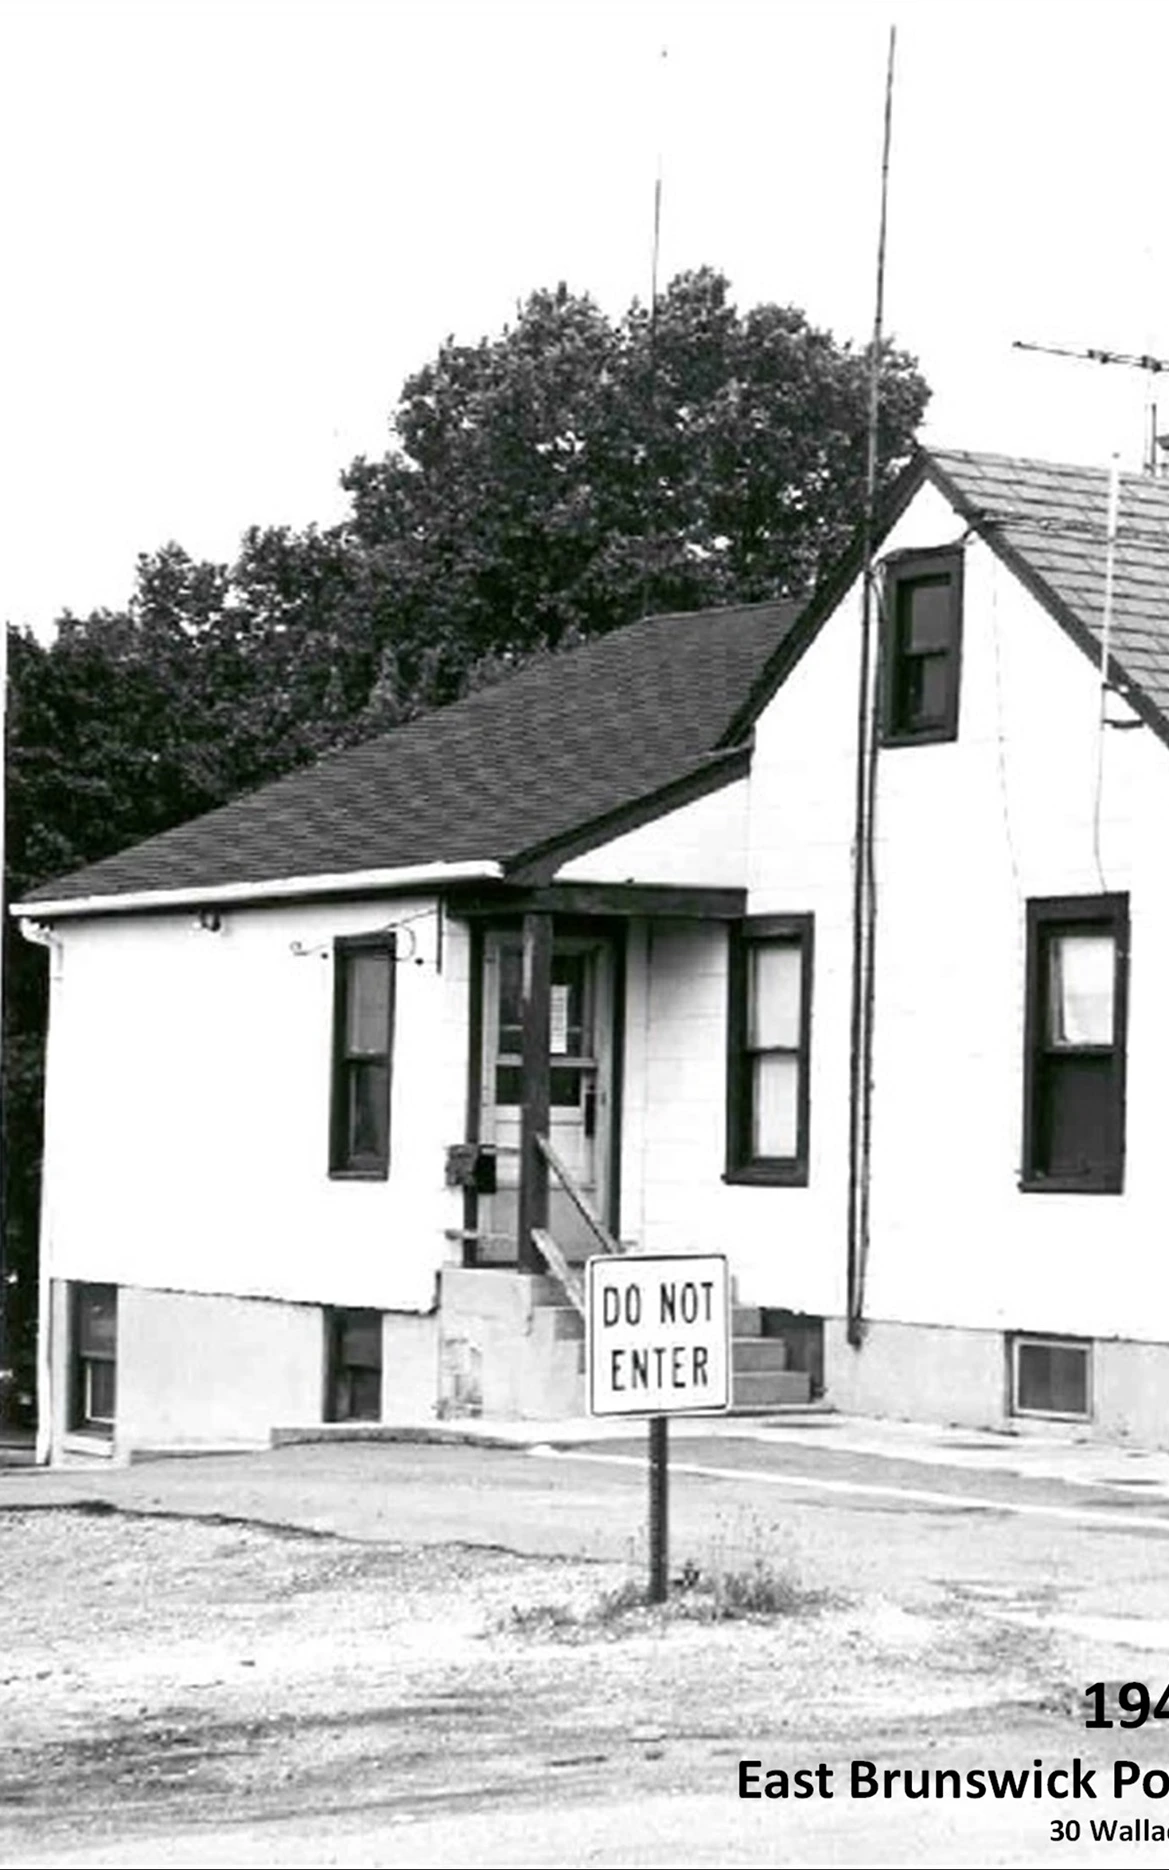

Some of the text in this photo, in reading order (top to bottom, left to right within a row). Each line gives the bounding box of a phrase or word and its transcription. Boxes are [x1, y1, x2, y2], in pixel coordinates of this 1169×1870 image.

[603, 1281, 714, 1328] DO NOT
[611, 1346, 708, 1392] ENTER
